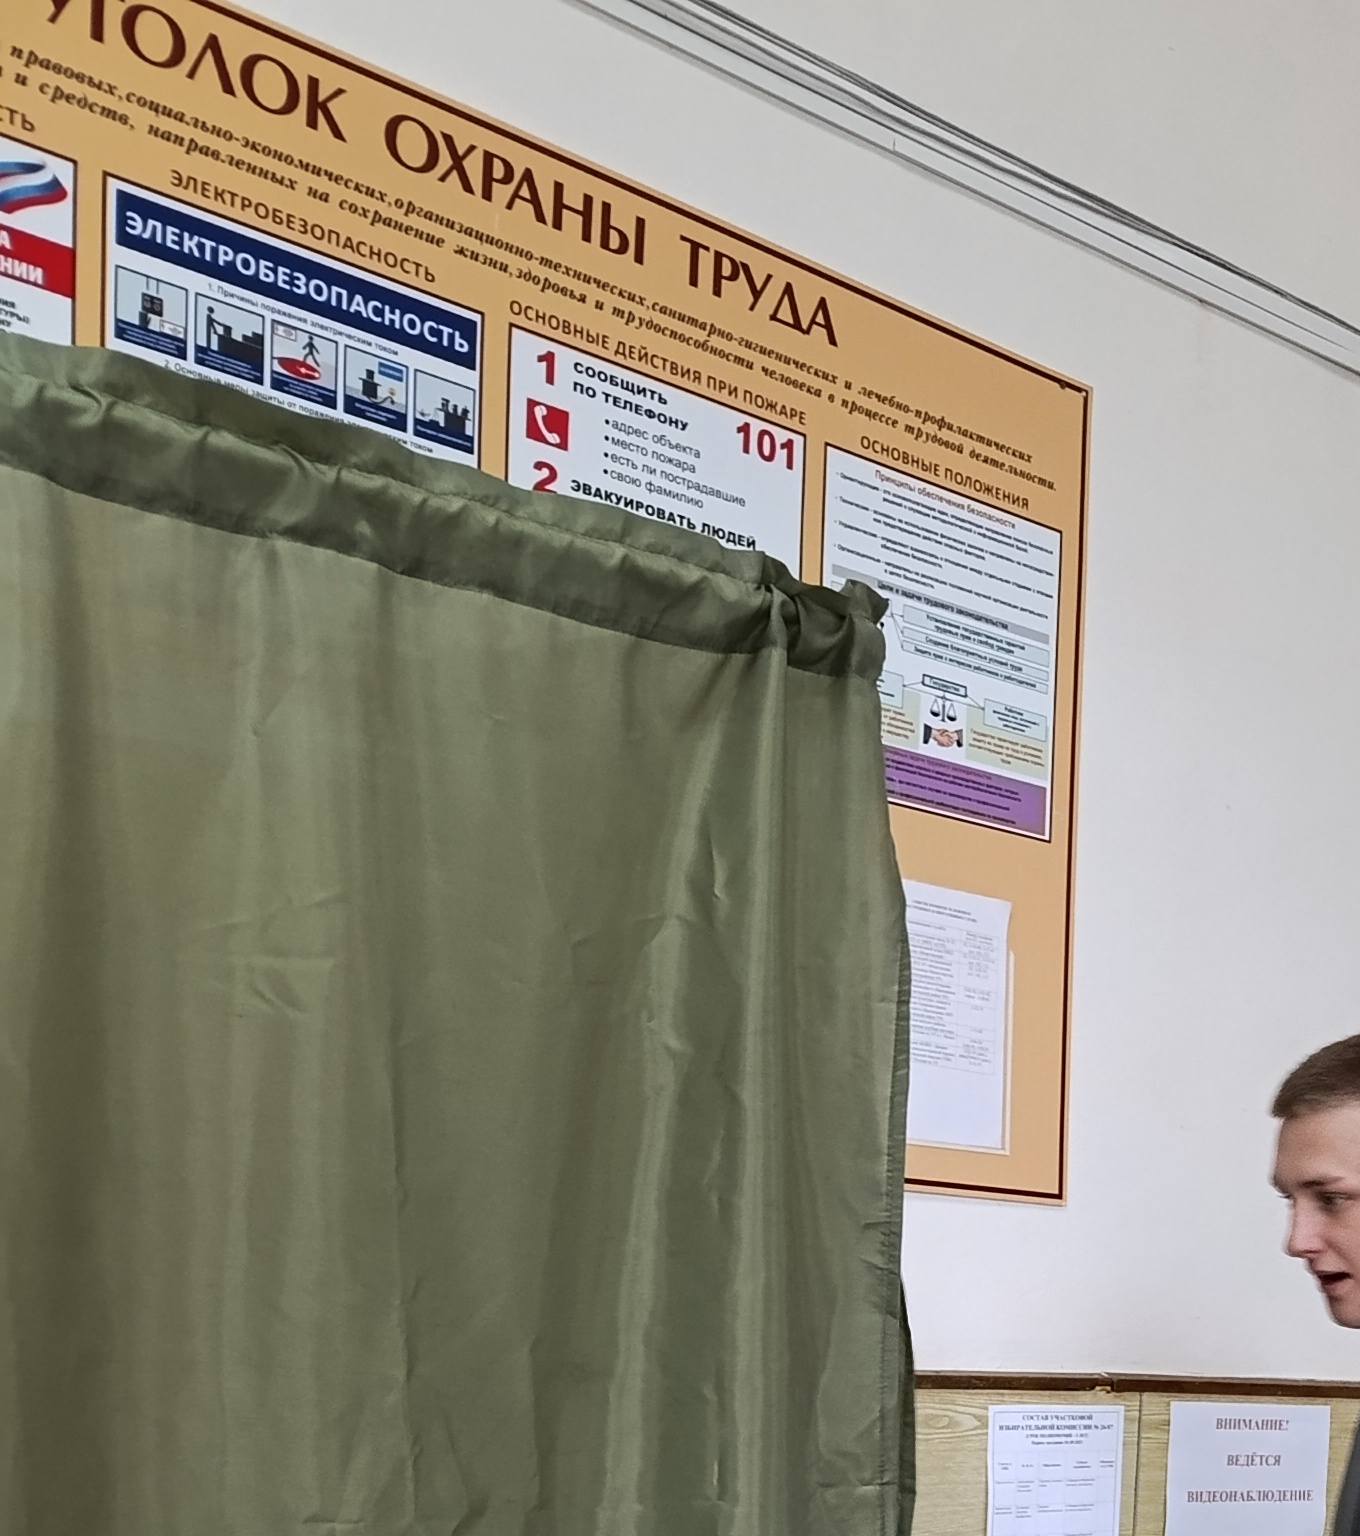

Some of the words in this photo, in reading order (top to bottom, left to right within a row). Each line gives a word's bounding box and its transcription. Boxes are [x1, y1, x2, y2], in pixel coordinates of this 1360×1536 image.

[169, 168, 437, 284] ЭЛЕКТРОБЕЗОПАСНОСТЬ
[383, 113, 646, 266] ОХРАНЫ
[679, 233, 839, 348] ТРУДА
[14, 72, 28, 87] и
[38, 82, 135, 130] средств,
[147, 122, 299, 191] направленных
[306, 185, 331, 204] на
[338, 198, 446, 249] сохранение
[594, 298, 605, 312] и
[611, 304, 755, 371] трудоспособности
[760, 365, 823, 398] человека
[840, 397, 899, 429] процессе
[903, 423, 965, 455] трудовой
[968, 447, 1058, 492] деятельности.
[124, 210, 471, 354] ЭЛЕКТРОБЕЗОПАСНОСТЬ
[509, 300, 611, 351] ОСНОВНЫЕ
[614, 340, 702, 386] ДЕЙСТВИЯ
[706, 374, 739, 400] ПРИ
[743, 388, 807, 426] ПОЖАРЕ
[536, 350, 556, 387] 1
[573, 361, 668, 406] СООБЩИТЬ
[572, 381, 597, 399] ПО
[601, 391, 689, 432] ТЕЛЕФОНУ
[857, 385, 1034, 464] лечебно-профилактических
[610, 436, 649, 458] место
[651, 450, 697, 475] пожара
[611, 418, 649, 441] адрес
[652, 434, 702, 460] объекта
[735, 421, 795, 472] 101
[609, 469, 642, 488] свою
[644, 480, 704, 510] фамилию
[610, 453, 638, 471] есть
[641, 464, 657, 477] ли
[660, 469, 747, 508] пострадавшие
[860, 435, 941, 478] ОСНОВНЫЕ
[944, 467, 1030, 511] ПОЛОЖЕНИЯ
[874, 469, 916, 493] Принципы
[966, 503, 1016, 530] безопасности
[532, 460, 559, 495] 2
[569, 479, 697, 531] ЭВАКУИРОВАТЬ
[699, 522, 757, 551] ЛЮДЕЙ
[1215, 1417, 1290, 1433] ВНИМАНИЕ!
[1226, 1450, 1282, 1468] ВЕДЁТСЯ
[1186, 1488, 1315, 1505] ВИДЕОНАБЛЮДЕНИЕ
